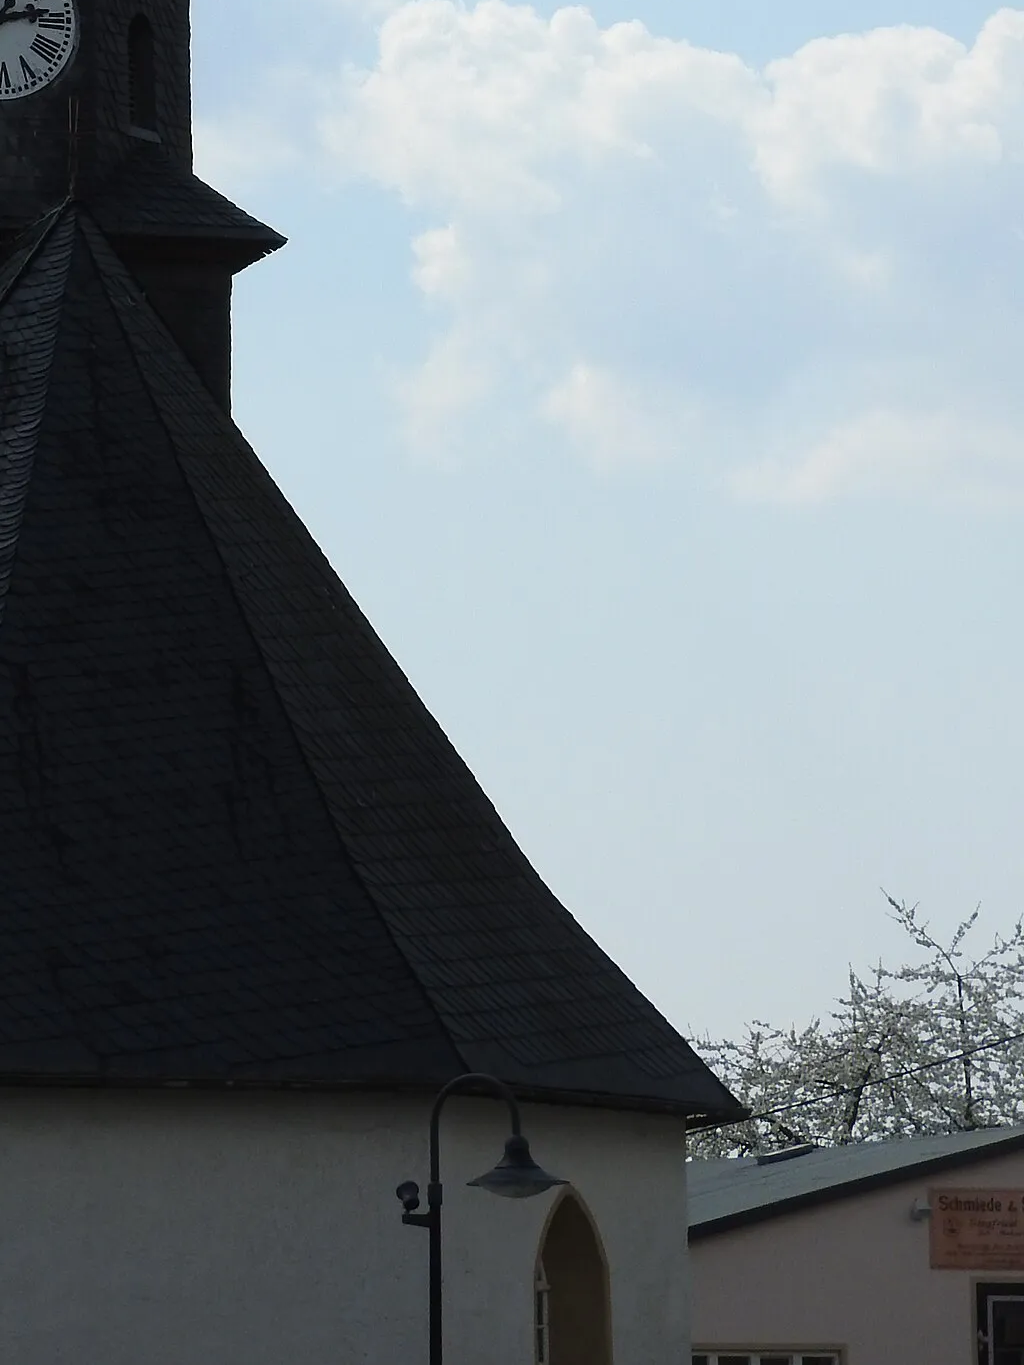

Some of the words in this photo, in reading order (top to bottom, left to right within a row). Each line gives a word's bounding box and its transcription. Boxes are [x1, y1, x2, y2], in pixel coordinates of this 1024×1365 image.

[30, 34, 61, 64] IIII
[19, 55, 36, 82] V
[938, 1195, 1002, 1212] Schmiede
